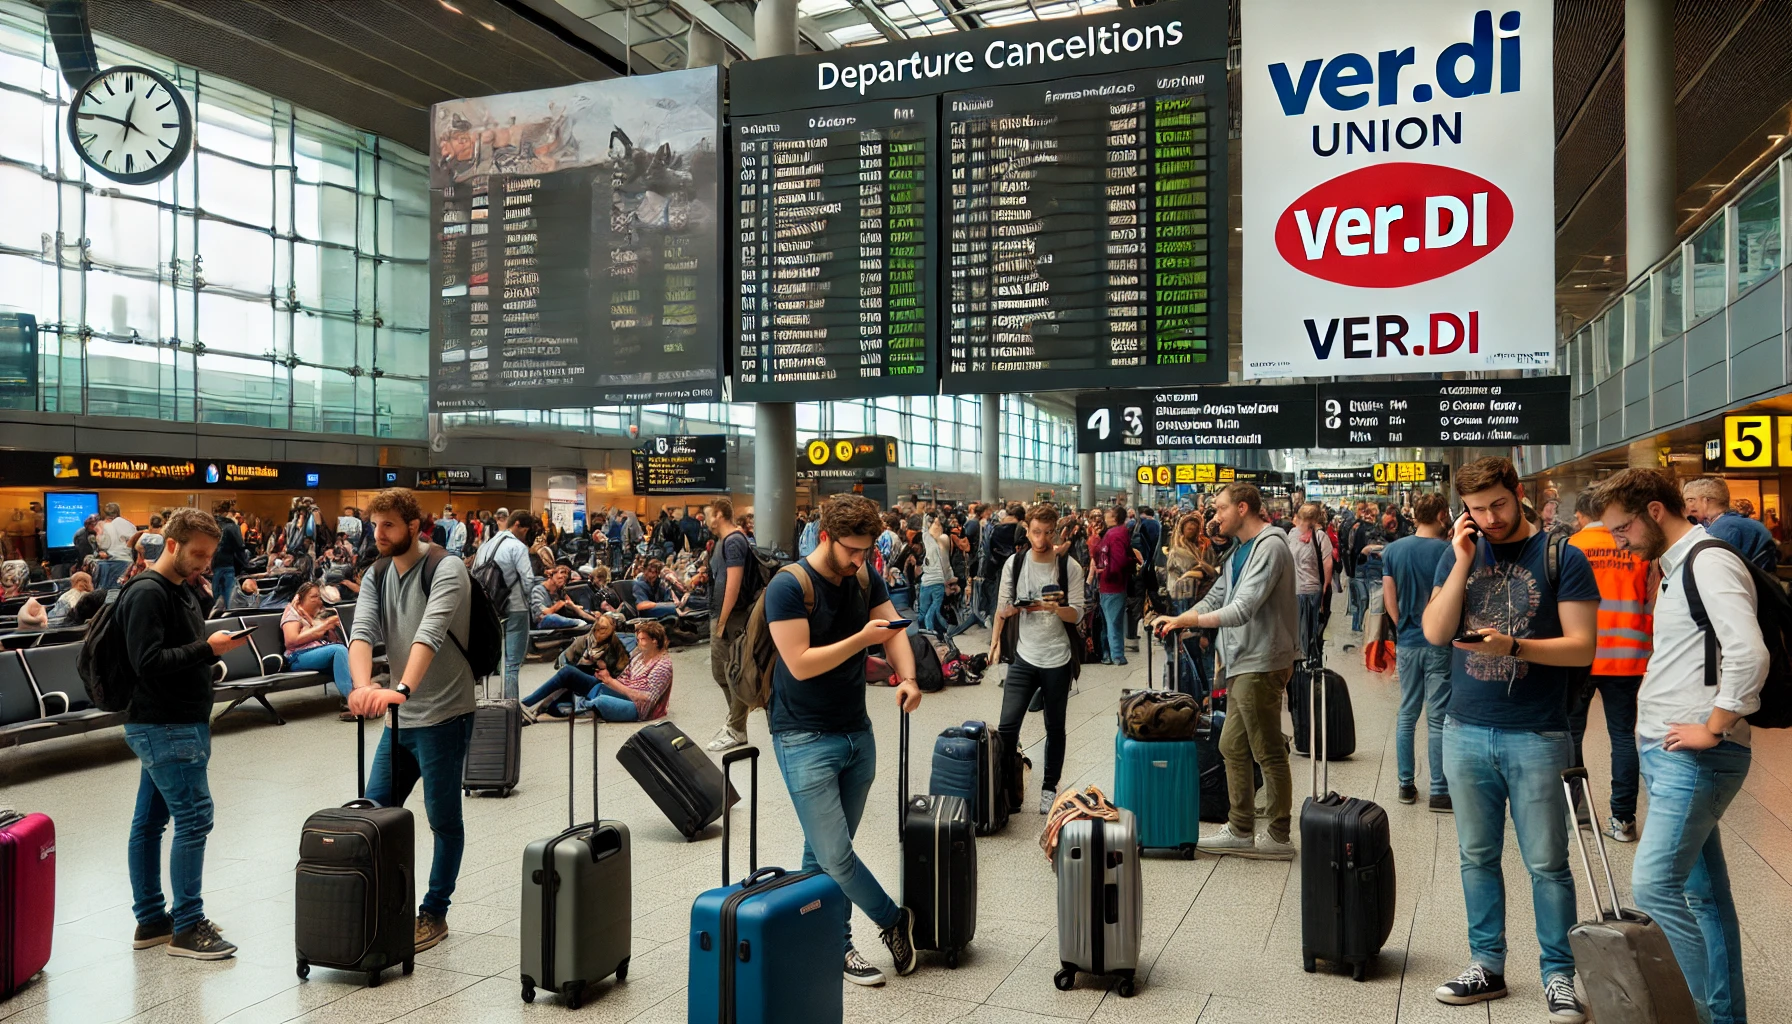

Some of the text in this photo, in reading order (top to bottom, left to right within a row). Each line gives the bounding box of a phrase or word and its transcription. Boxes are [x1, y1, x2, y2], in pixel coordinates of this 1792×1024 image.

[818, 20, 1183, 95] Departure Canceltions
[1268, 10, 1521, 116] ver.di
[1312, 111, 1462, 157] UNION
[1304, 311, 1479, 360] VER.DI
[1732, 421, 1763, 462] 5
